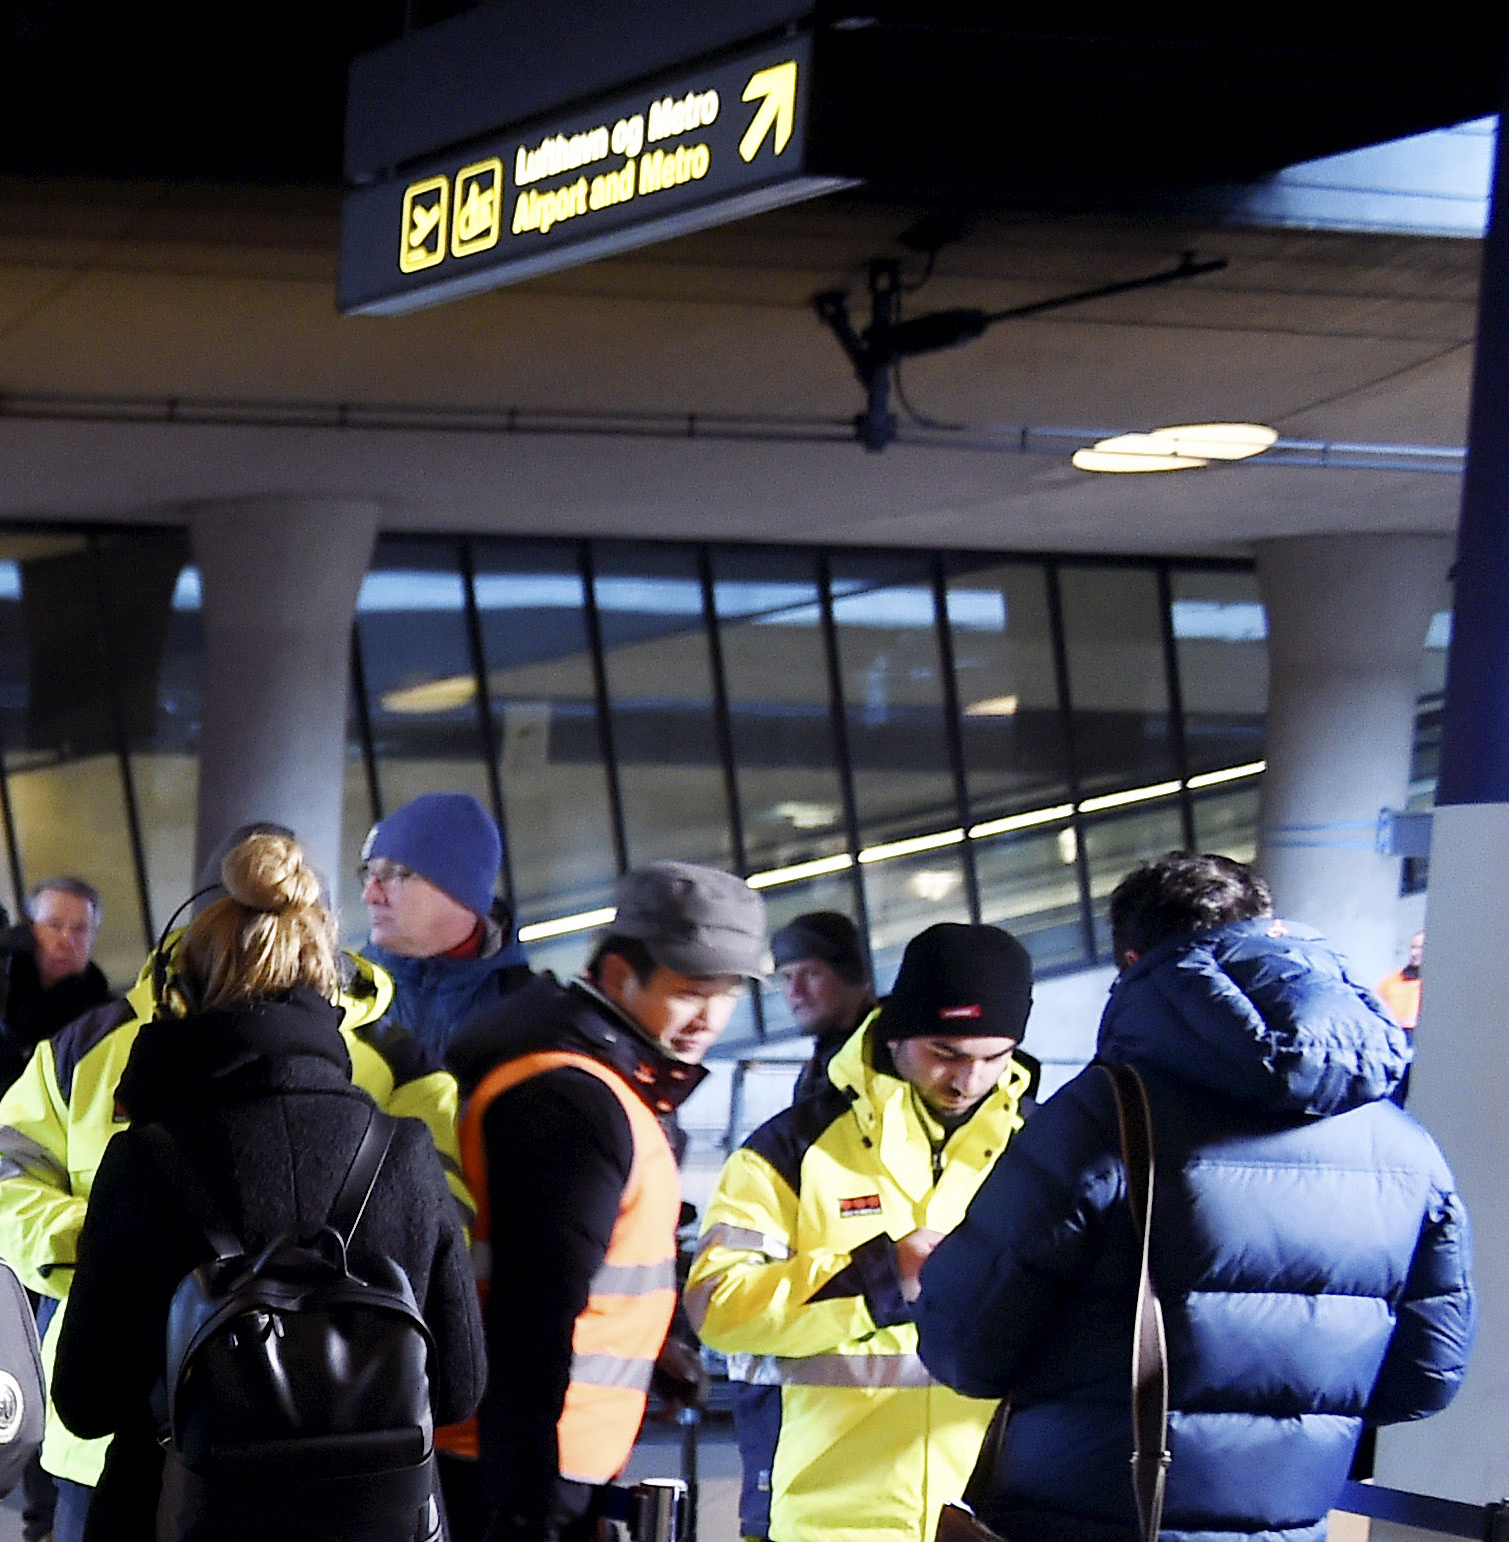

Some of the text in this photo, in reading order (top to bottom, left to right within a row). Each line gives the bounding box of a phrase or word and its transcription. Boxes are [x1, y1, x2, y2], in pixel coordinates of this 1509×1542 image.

[514, 88, 720, 187] Lufthavn og Metro
[511, 142, 710, 235] Airport and Metro
